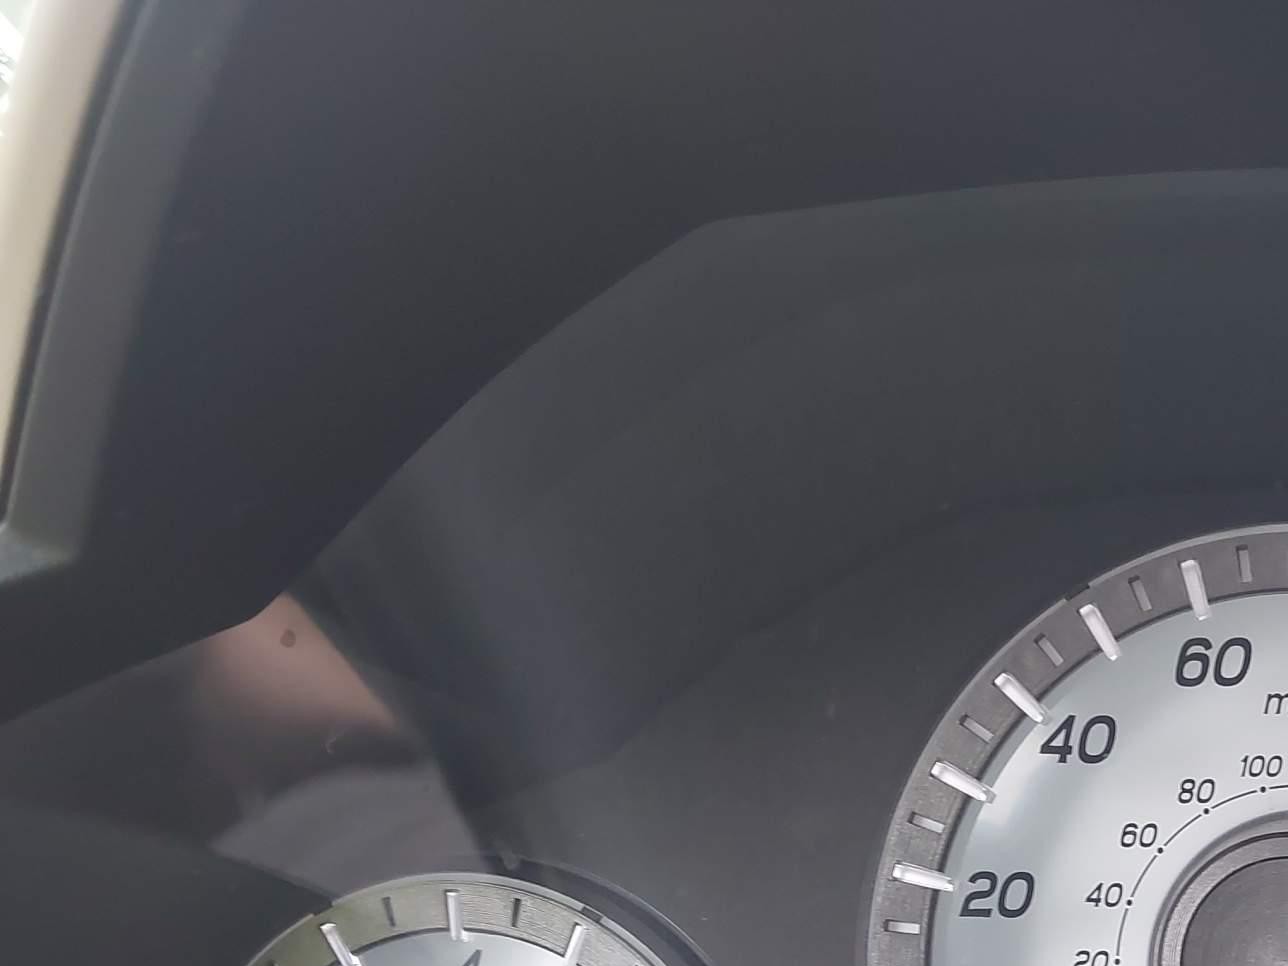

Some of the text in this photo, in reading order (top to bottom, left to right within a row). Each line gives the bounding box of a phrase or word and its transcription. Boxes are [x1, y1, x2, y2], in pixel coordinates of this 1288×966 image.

[1175, 637, 1252, 687] 60
[1039, 715, 1116, 764] 40
[1241, 755, 1283, 778] 100
[1178, 779, 1215, 804] 80
[1120, 823, 1158, 848] 60
[960, 871, 1034, 919] 20
[1085, 883, 1123, 908] 40
